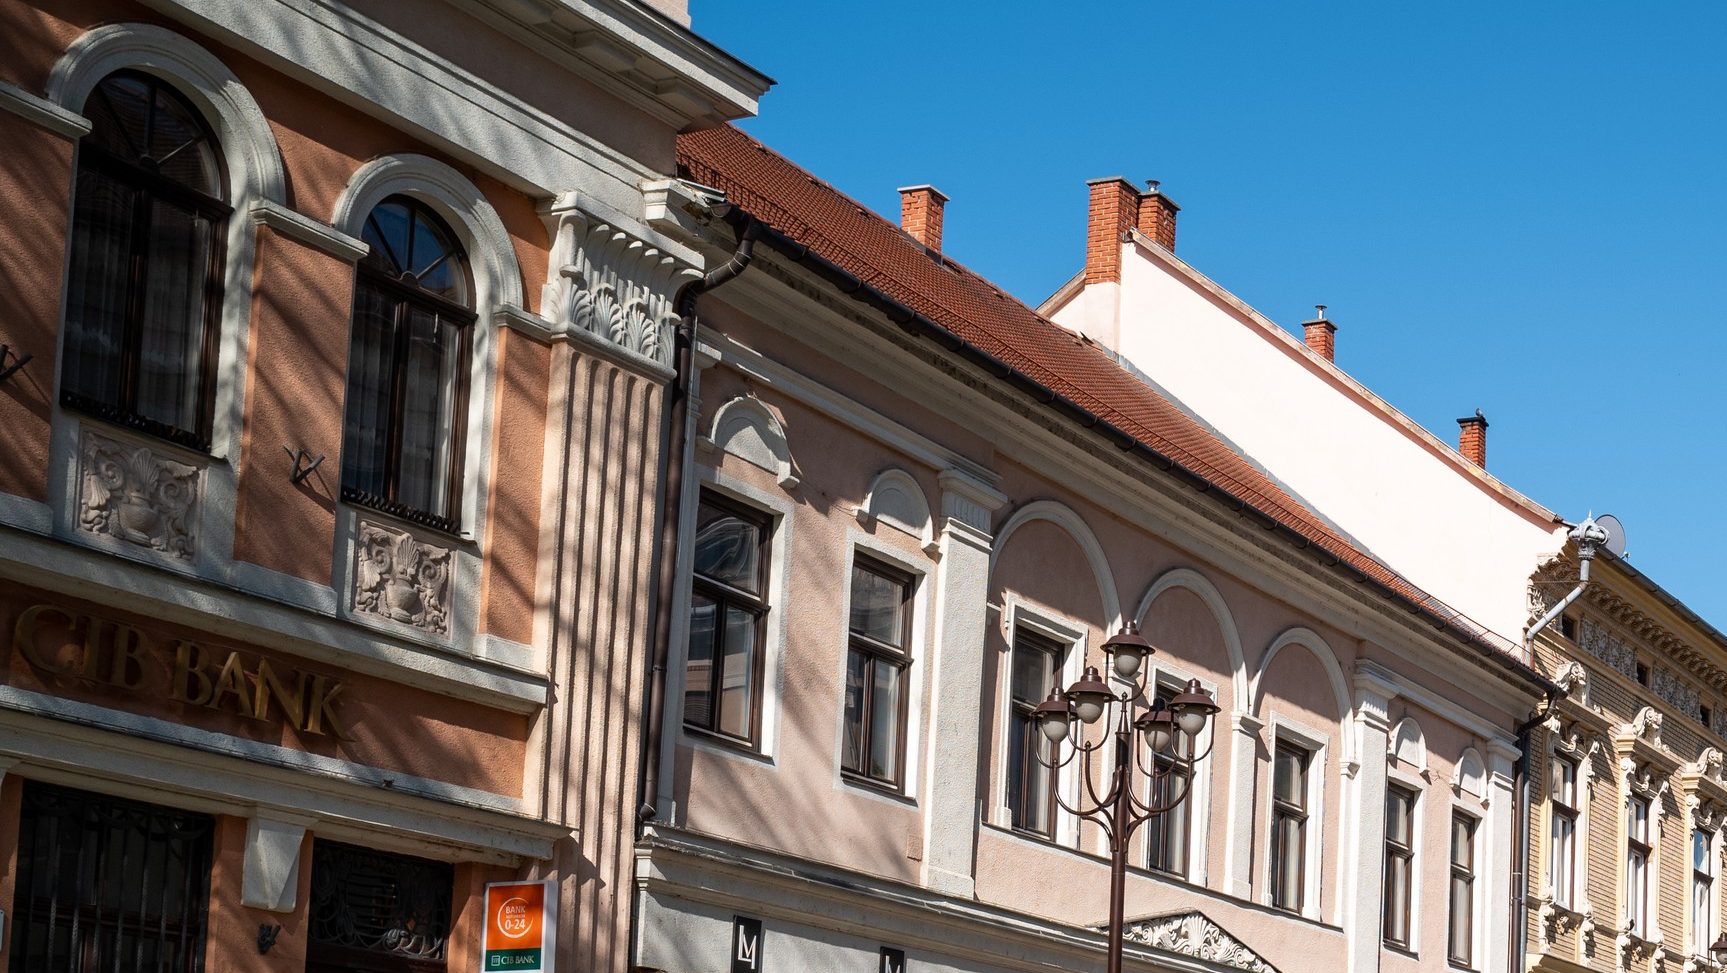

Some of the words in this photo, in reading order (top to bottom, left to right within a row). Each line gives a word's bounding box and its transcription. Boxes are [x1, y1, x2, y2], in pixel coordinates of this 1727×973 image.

[14, 605, 149, 690] CIB
[168, 639, 355, 743] BANK
[505, 906, 526, 914] BANK
[504, 919, 526, 930] 0-24
[501, 956, 514, 965] CIB
[515, 955, 535, 964] BANK
